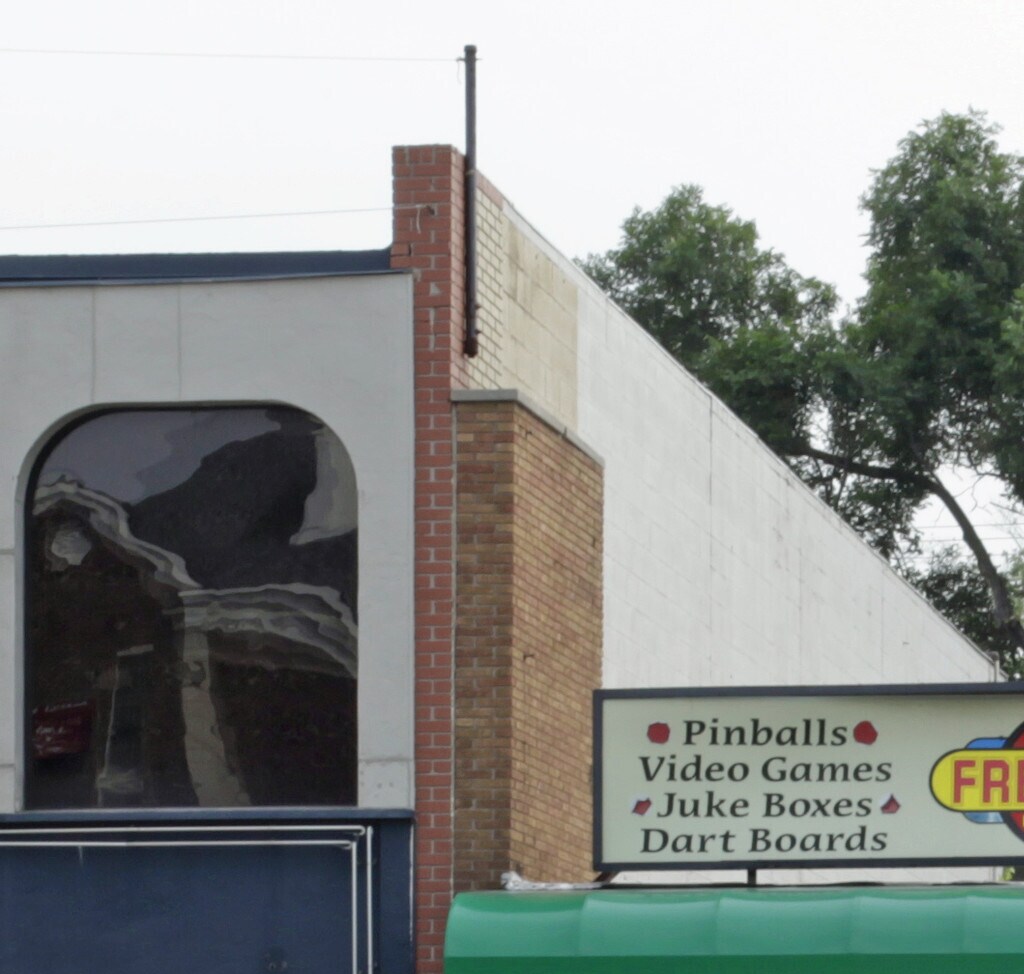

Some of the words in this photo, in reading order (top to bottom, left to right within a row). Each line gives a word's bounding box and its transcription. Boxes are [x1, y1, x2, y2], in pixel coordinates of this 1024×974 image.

[683, 717, 848, 747] Pinballs
[638, 754, 750, 782] Video
[761, 756, 892, 783] Games
[657, 790, 750, 818] Juke
[763, 792, 873, 818] Boxes
[640, 828, 736, 853] Dart
[749, 825, 888, 853] Boards
